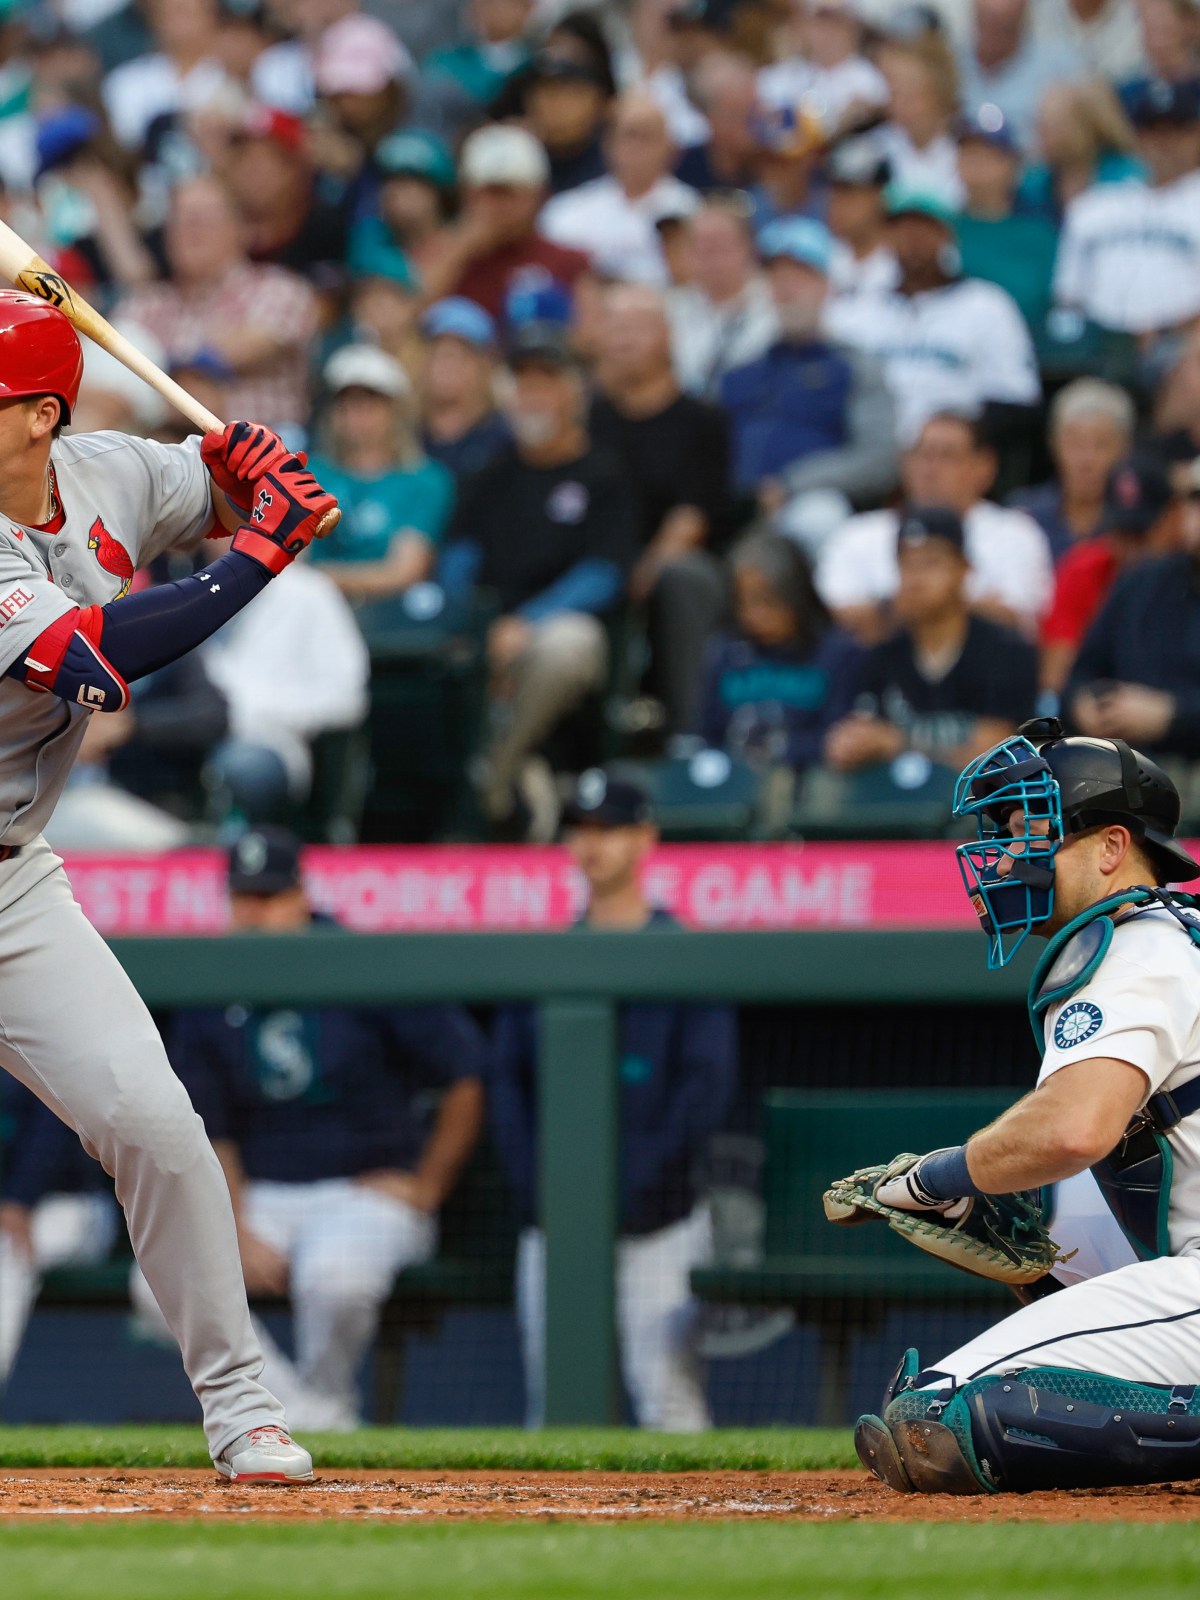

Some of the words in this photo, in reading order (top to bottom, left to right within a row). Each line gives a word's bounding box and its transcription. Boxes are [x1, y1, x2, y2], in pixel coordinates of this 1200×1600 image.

[166, 866, 474, 929] NWORK
[482, 863, 551, 925] IN
[558, 862, 682, 925] TE
[690, 862, 876, 925] GAME
[1056, 1003, 1100, 1029] SEATTLE
